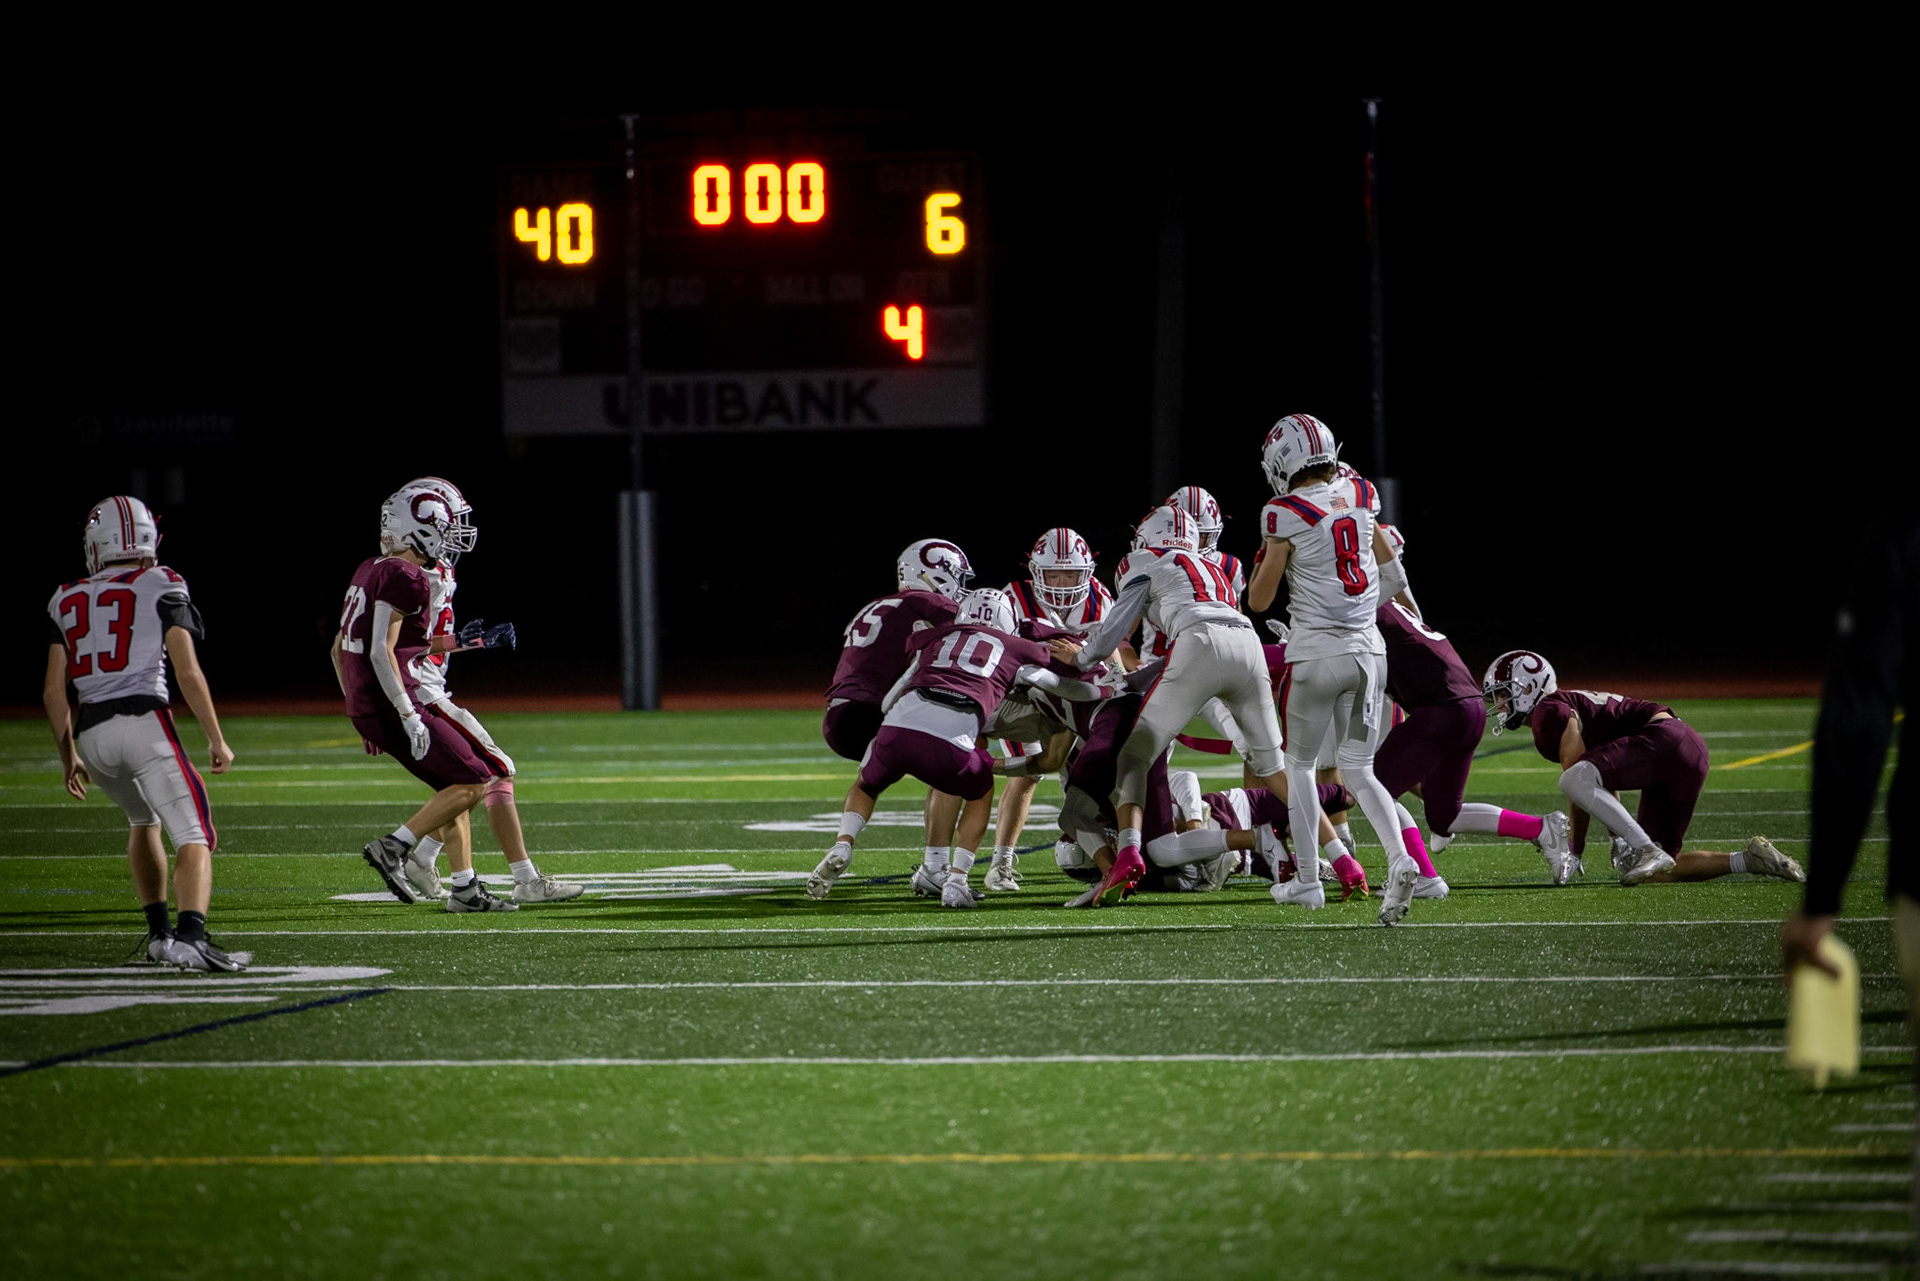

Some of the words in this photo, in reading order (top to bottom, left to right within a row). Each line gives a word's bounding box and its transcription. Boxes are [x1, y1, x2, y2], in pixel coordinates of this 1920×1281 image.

[513, 202, 594, 265] 40
[924, 192, 967, 255] 6
[883, 305, 925, 361] 4
[602, 378, 881, 428] UNIBANK
[1162, 538, 1193, 551] Riddell
[1266, 511, 1278, 534] 8
[1331, 516, 1369, 597] 8
[59, 588, 137, 679] 23
[978, 605, 993, 621] 10
[930, 630, 1005, 679] 10
